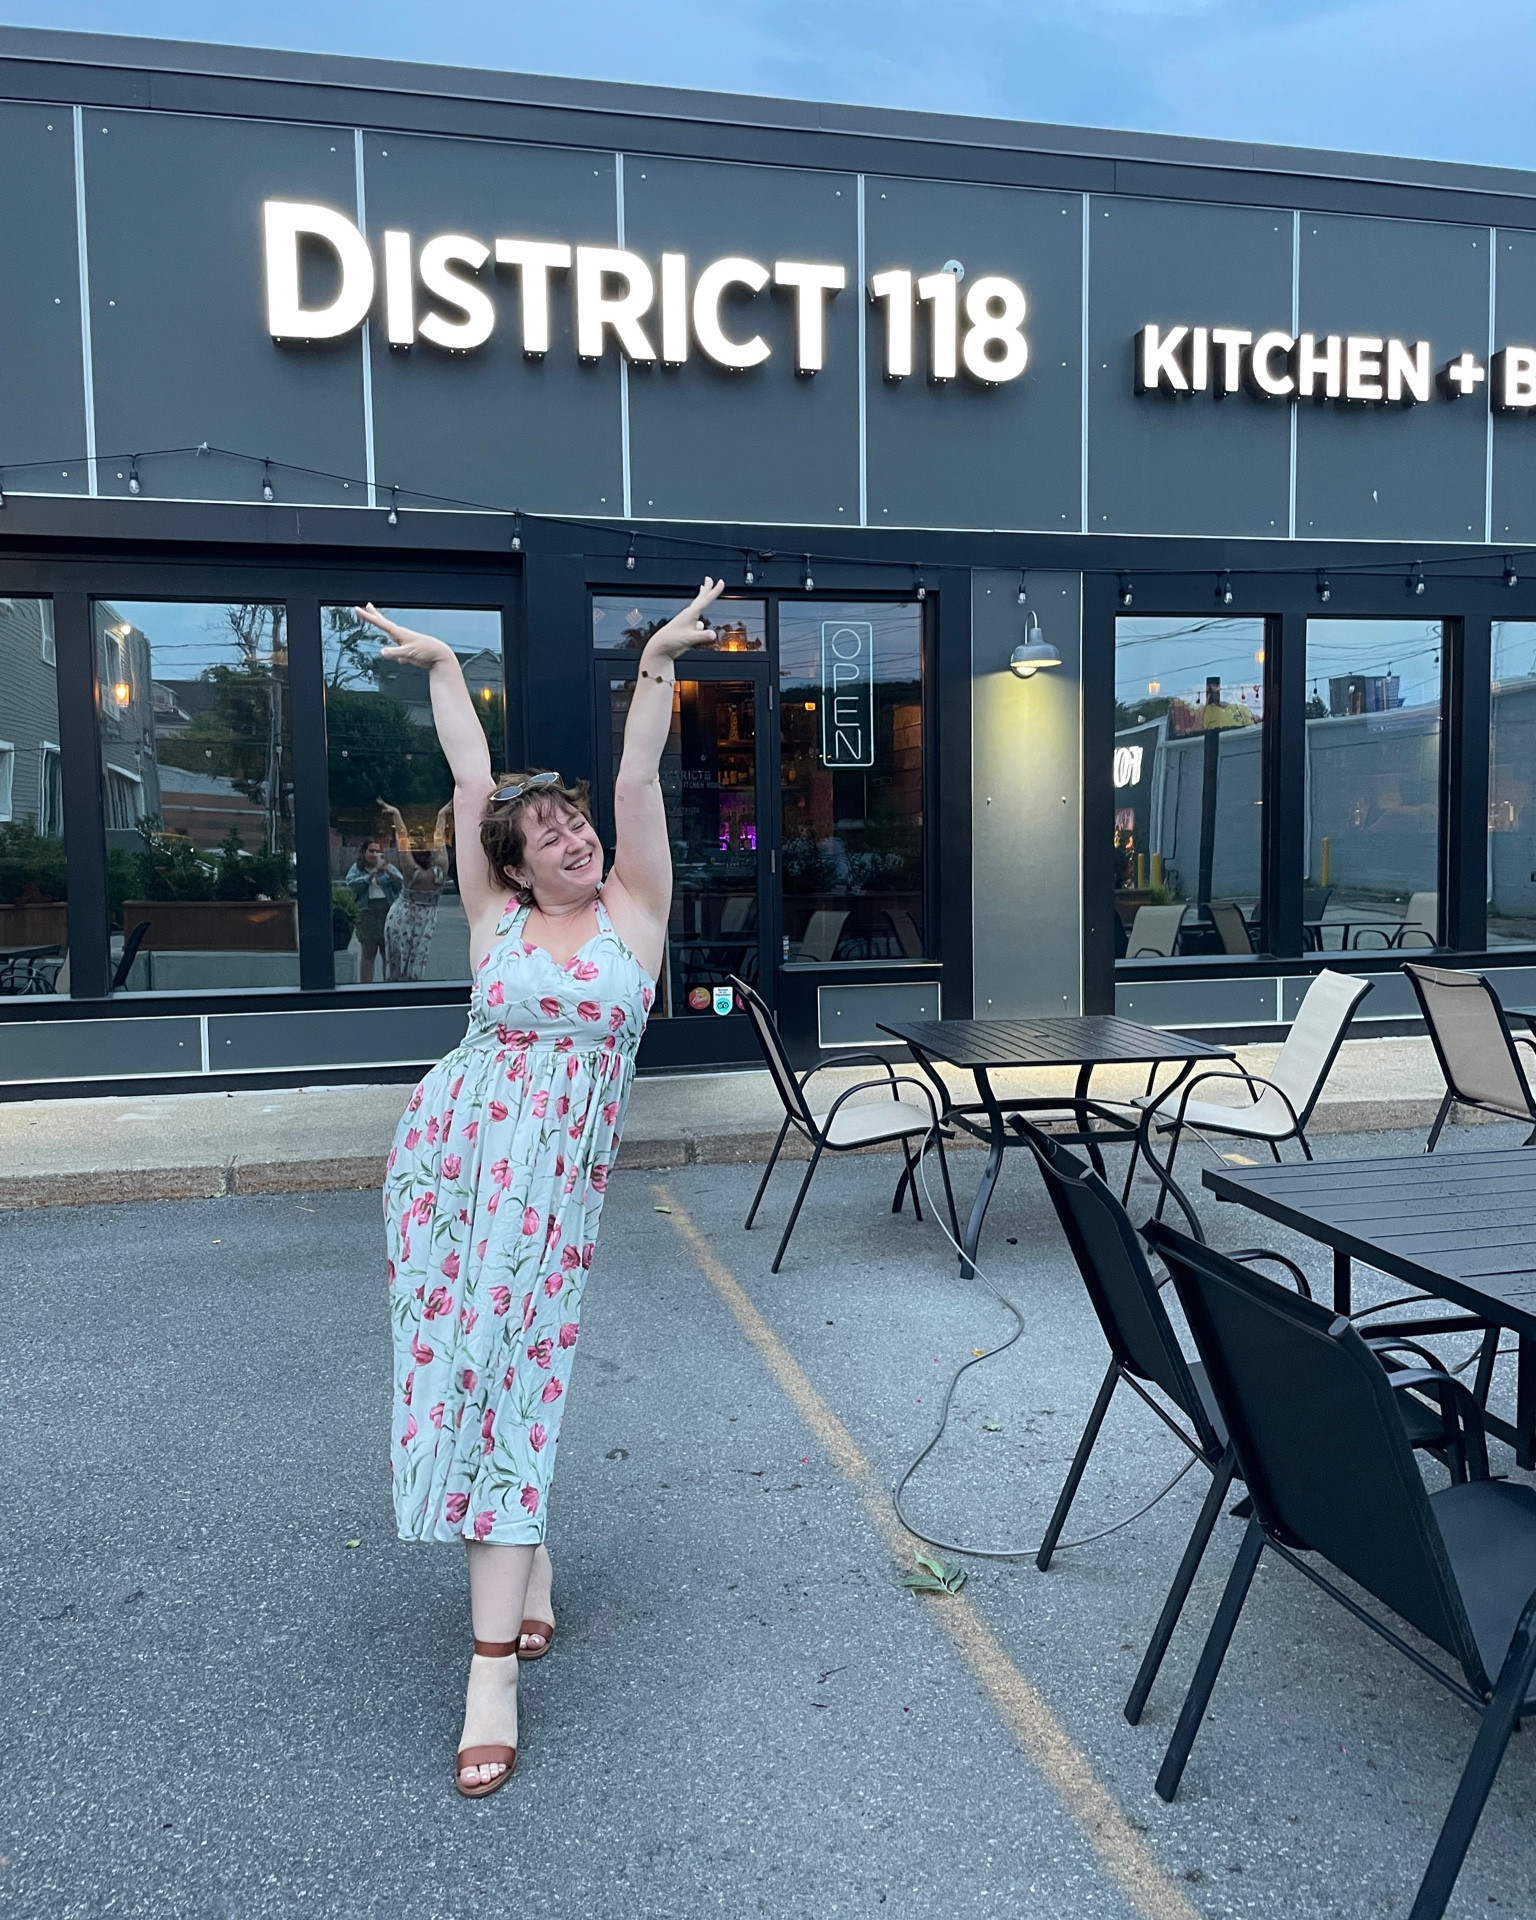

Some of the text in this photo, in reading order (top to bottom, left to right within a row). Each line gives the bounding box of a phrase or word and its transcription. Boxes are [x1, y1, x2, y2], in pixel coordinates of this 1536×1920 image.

[263, 200, 1028, 383] DISTRICT 118
[1142, 323, 1430, 402] KITCHEN
[1449, 352, 1485, 394] +
[831, 628, 862, 760] OPEN
